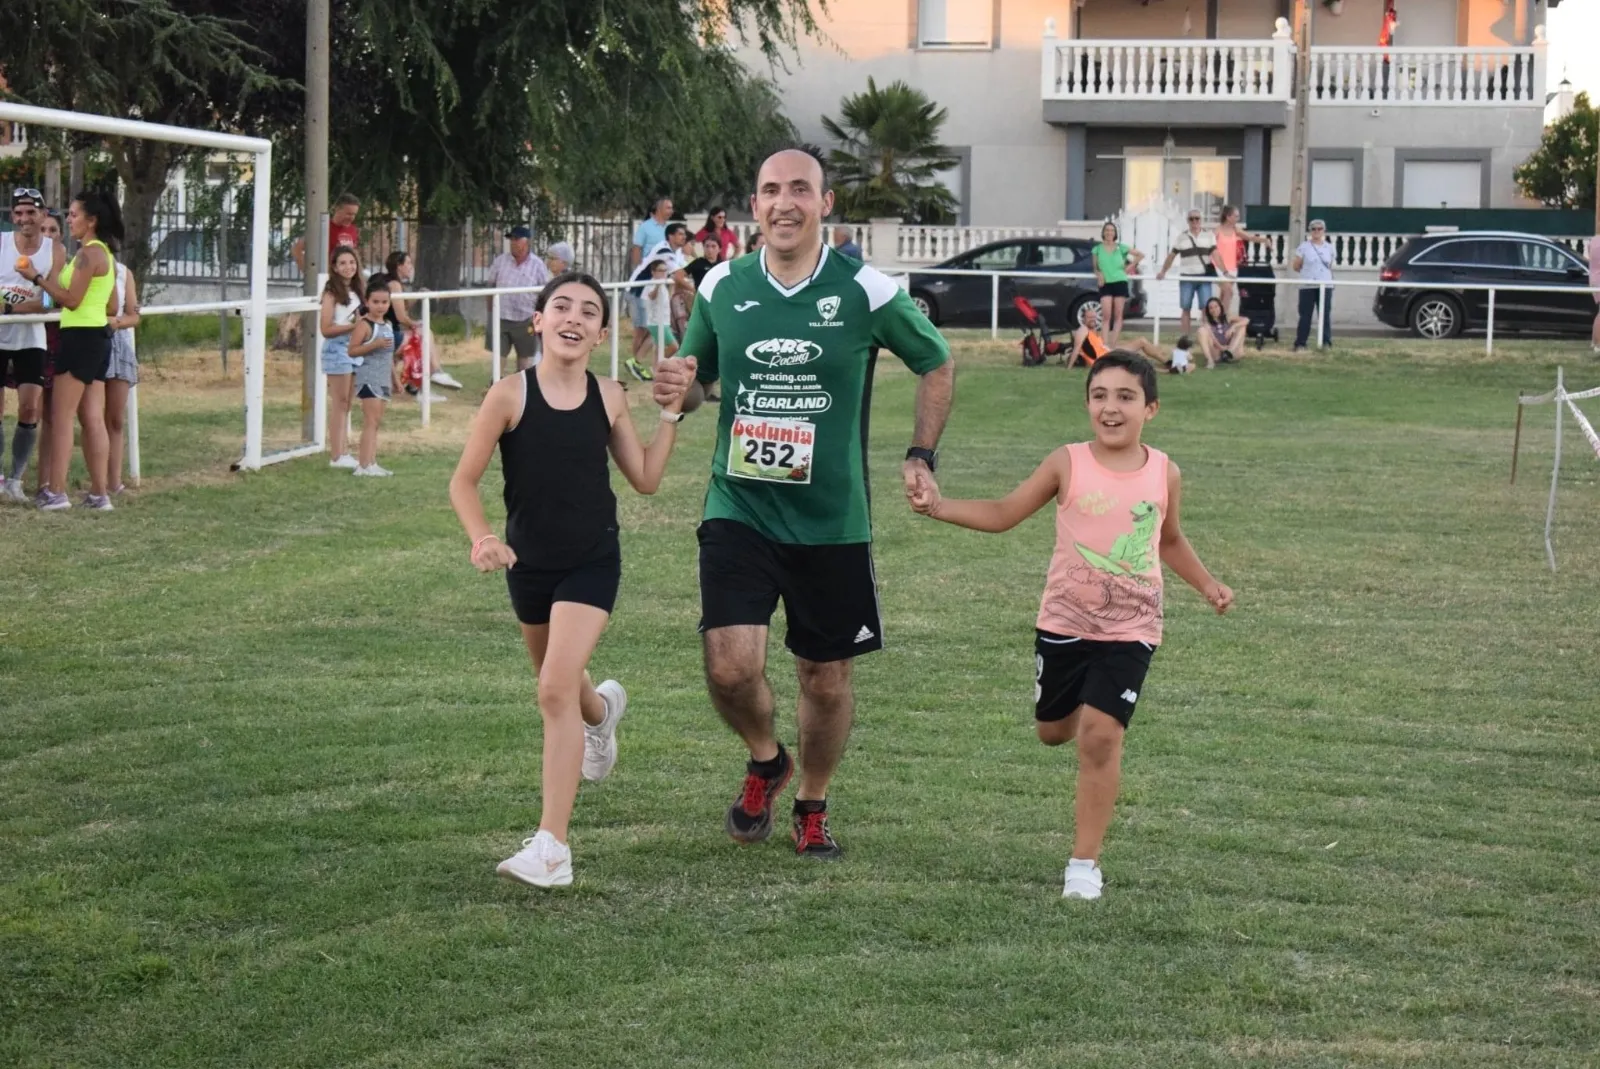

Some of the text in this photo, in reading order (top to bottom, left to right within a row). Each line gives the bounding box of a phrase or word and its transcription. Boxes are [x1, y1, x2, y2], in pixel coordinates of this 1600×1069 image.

[757, 337, 813, 353] ARC
[768, 351, 810, 368] Racing
[749, 372, 817, 383] arc-racing.com
[755, 396, 827, 410] GARLAND
[733, 418, 812, 445] bedunia
[744, 439, 795, 469] 252
